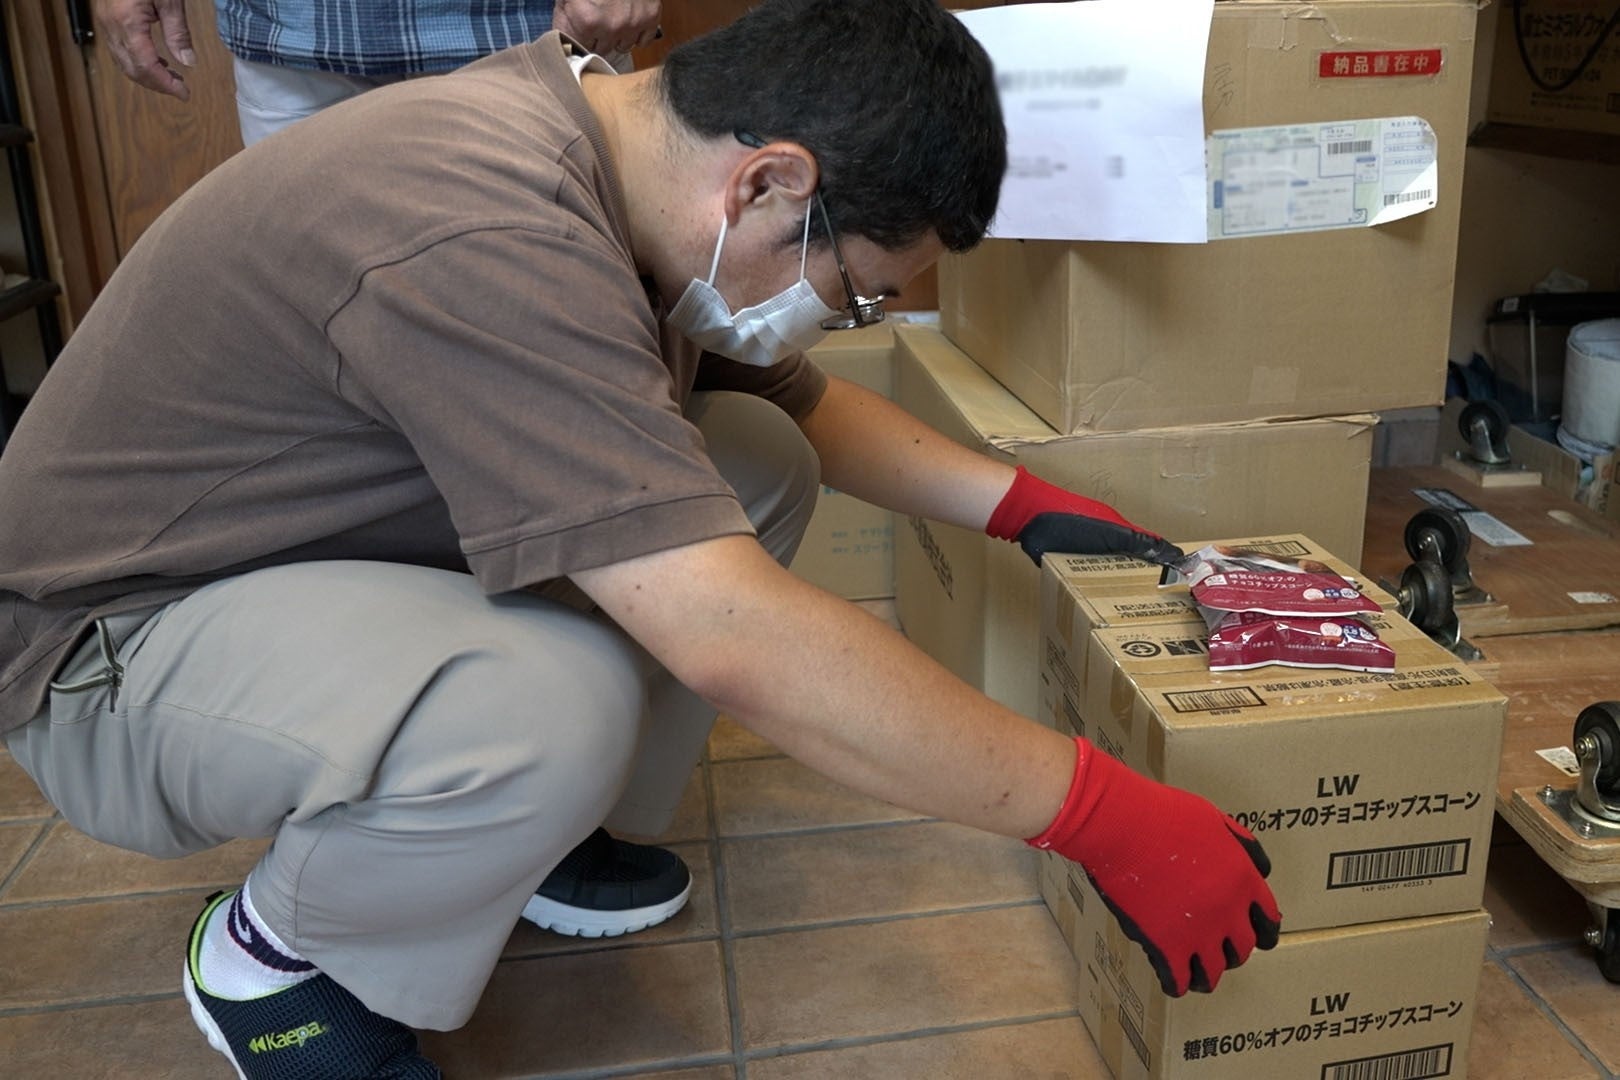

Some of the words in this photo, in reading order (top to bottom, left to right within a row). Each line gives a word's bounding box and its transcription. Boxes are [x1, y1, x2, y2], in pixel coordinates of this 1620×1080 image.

[1332, 52, 1430, 76] 納品書在中
[1316, 774, 1360, 799] LW
[1227, 791, 1481, 833] 0%オフのチョコチップスコーン
[1310, 992, 1350, 1016] LW
[265, 1021, 323, 1048] Kaepa
[1182, 1000, 1464, 1062] 糖質60%オフのチョコチップスコーン
